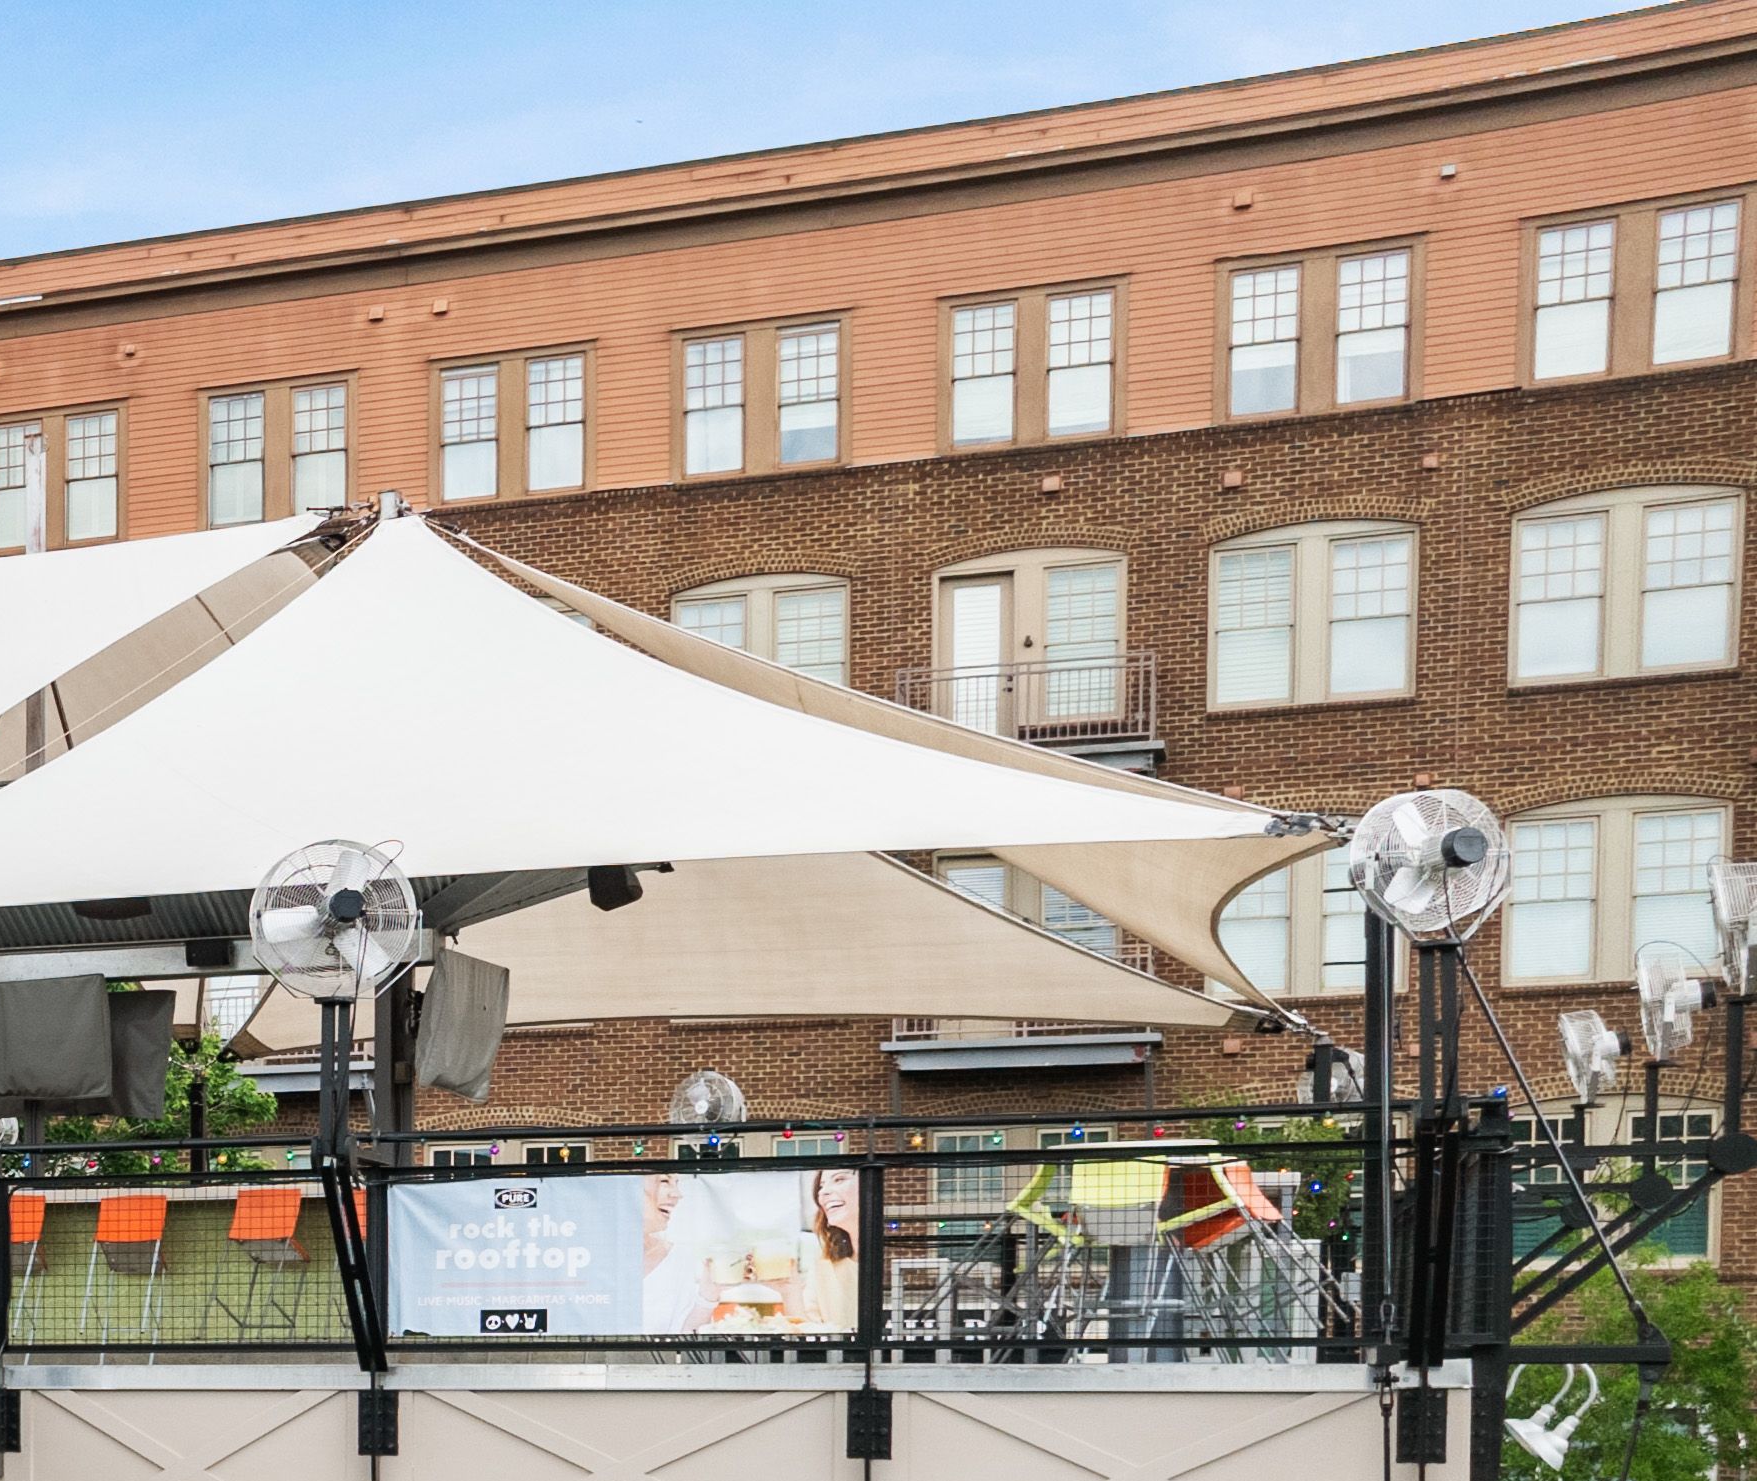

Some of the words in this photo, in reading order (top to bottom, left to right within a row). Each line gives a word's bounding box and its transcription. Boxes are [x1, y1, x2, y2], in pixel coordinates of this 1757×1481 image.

[501, 1193, 530, 1203] PURE
[448, 1215, 515, 1239] rock
[527, 1214, 577, 1237] the
[435, 1239, 591, 1277] rooftop
[417, 1296, 443, 1306] LIVE
[446, 1296, 483, 1306] MUSIC
[491, 1295, 566, 1305] MARGARITAS
[574, 1294, 611, 1304] MORE
